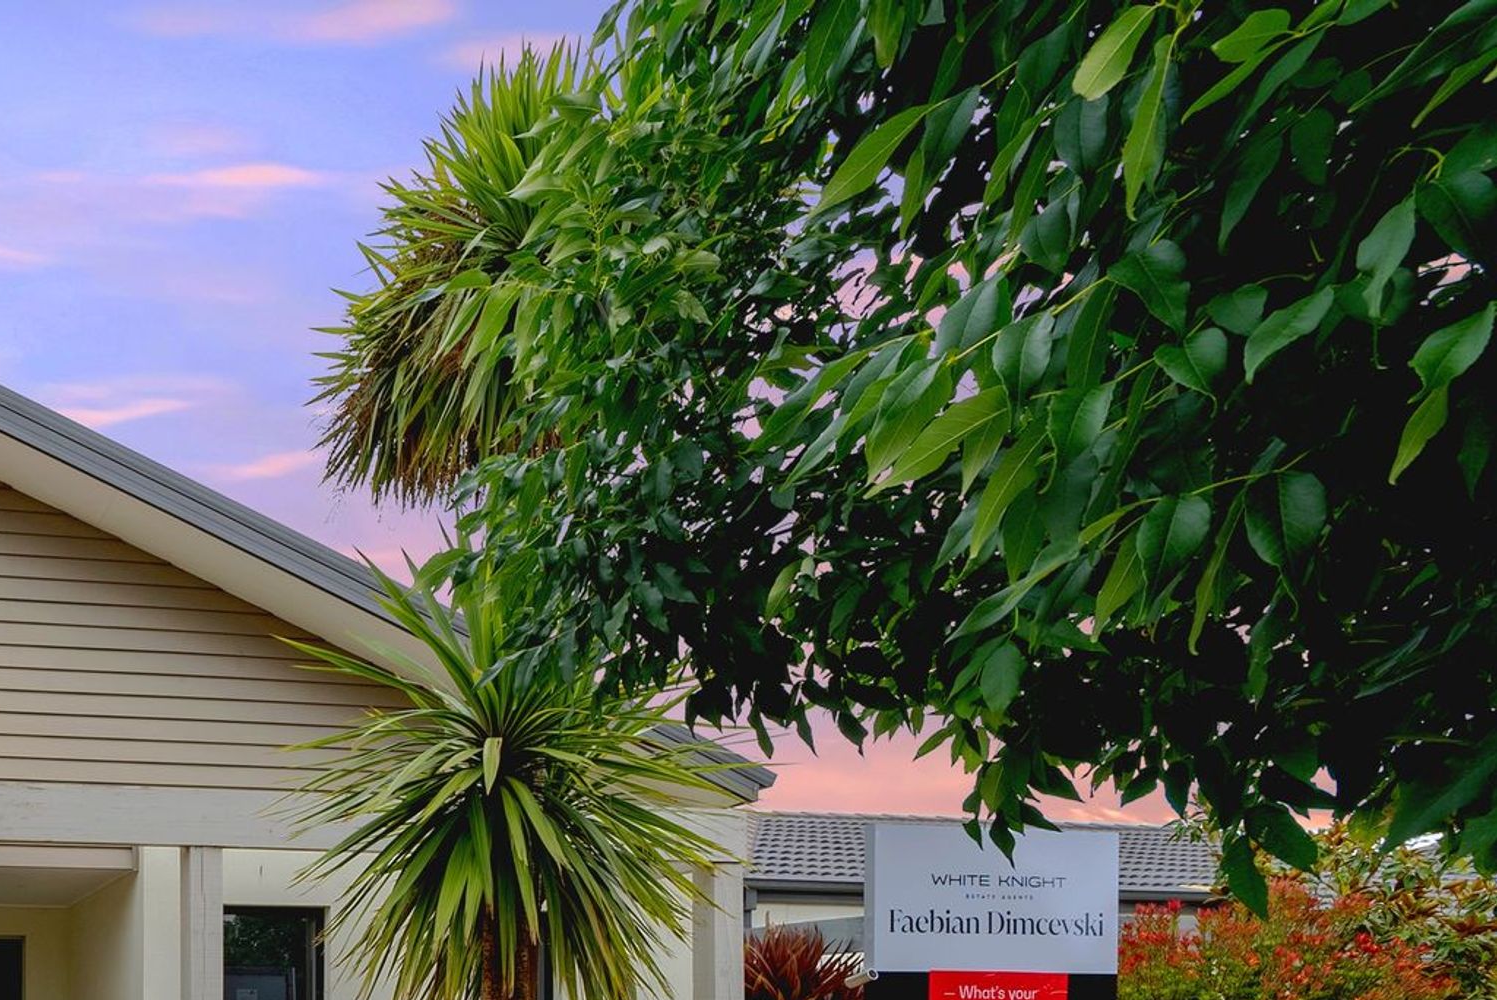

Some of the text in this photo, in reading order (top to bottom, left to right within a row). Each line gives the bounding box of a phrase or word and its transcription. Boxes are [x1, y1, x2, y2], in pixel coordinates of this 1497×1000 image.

[931, 874, 1067, 888] WHITE KNIGHT
[889, 909, 1104, 937] Faebian Dimcevski
[959, 985, 1005, 1000] What's
